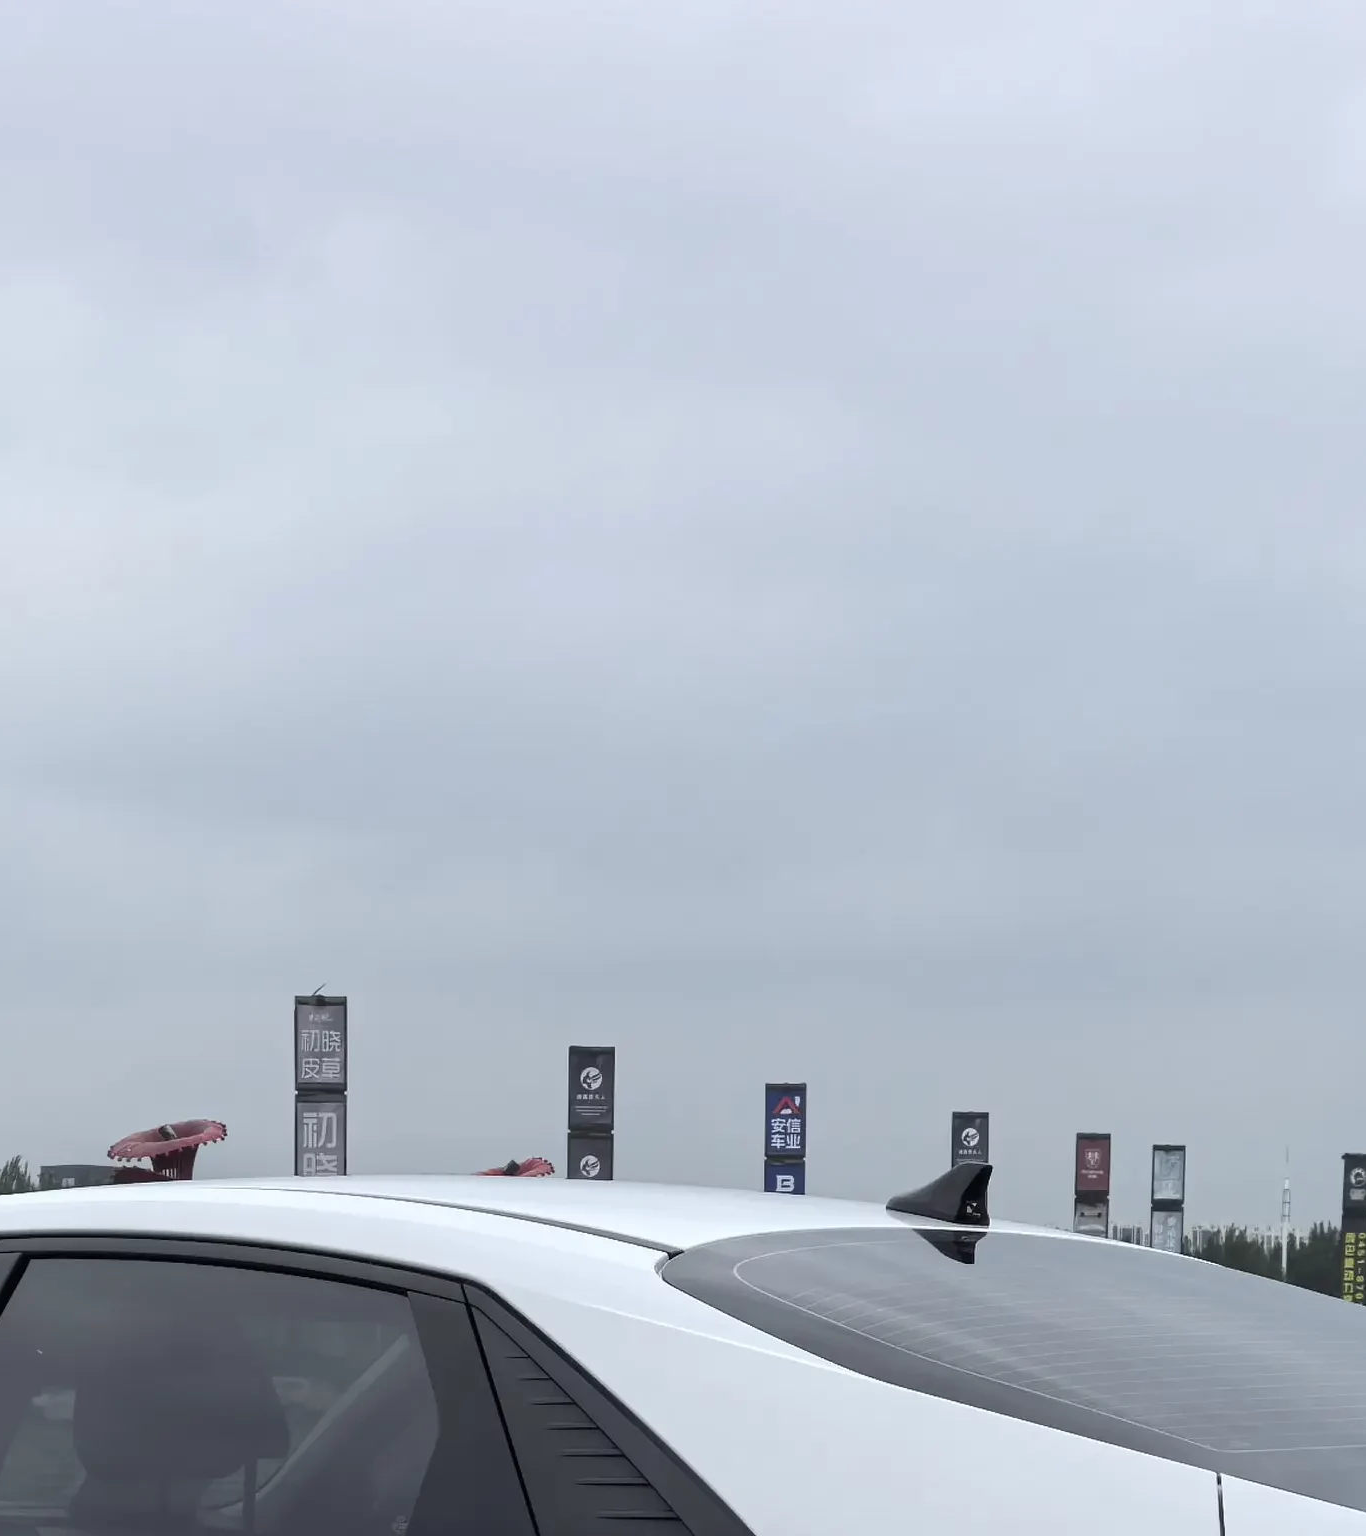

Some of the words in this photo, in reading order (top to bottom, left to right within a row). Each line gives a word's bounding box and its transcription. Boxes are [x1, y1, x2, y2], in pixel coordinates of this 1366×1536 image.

[300, 1029, 341, 1053] 初晓
[301, 1057, 341, 1080] 皮草
[770, 1117, 802, 1133] 安信
[770, 1133, 801, 1149] 车业
